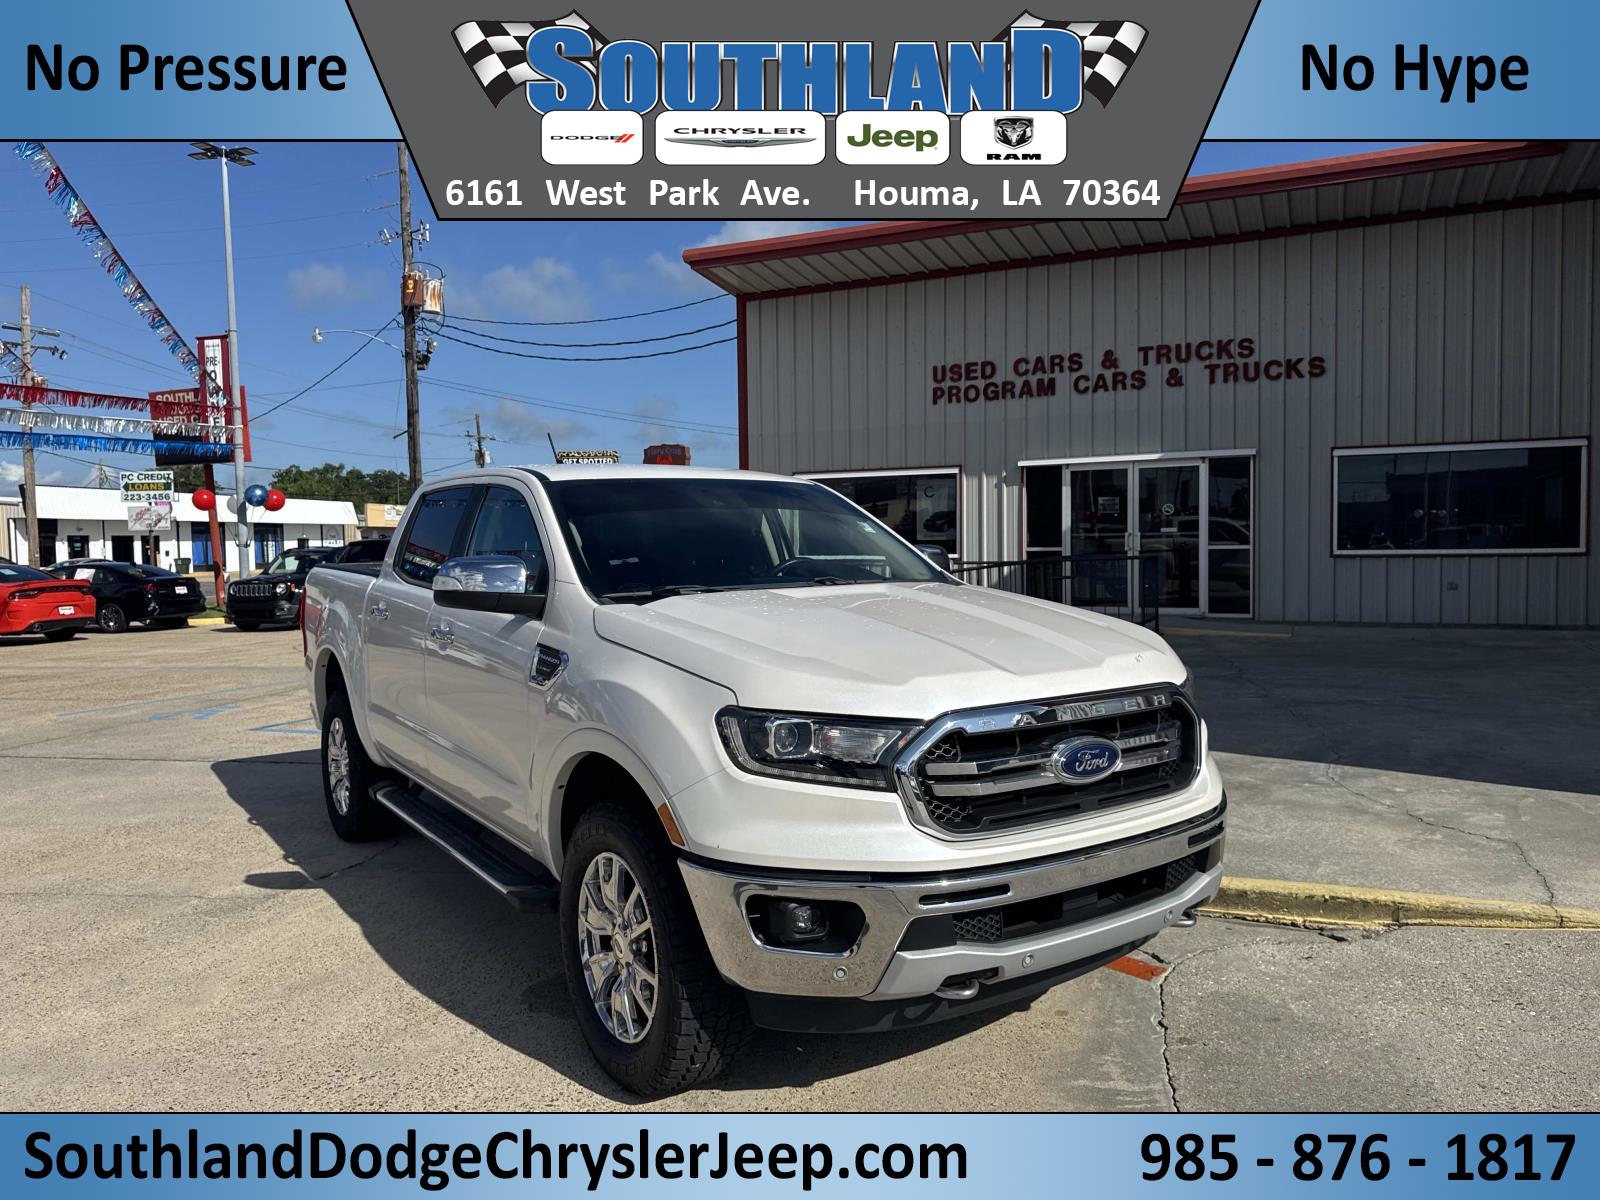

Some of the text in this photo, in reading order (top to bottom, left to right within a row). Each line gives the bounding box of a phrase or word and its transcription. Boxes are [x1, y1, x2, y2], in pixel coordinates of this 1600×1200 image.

[932, 338, 1255, 385] USED CARS & TRUCKS
[932, 356, 1327, 405] PROGRAM CARS & TRUCKS
[155, 391, 200, 404] SOUTHL
[121, 472, 172, 481] PC CREDIT
[129, 482, 165, 491] LOANS
[123, 493, 171, 501] 223-3456
[1075, 749, 1109, 772] Ford
